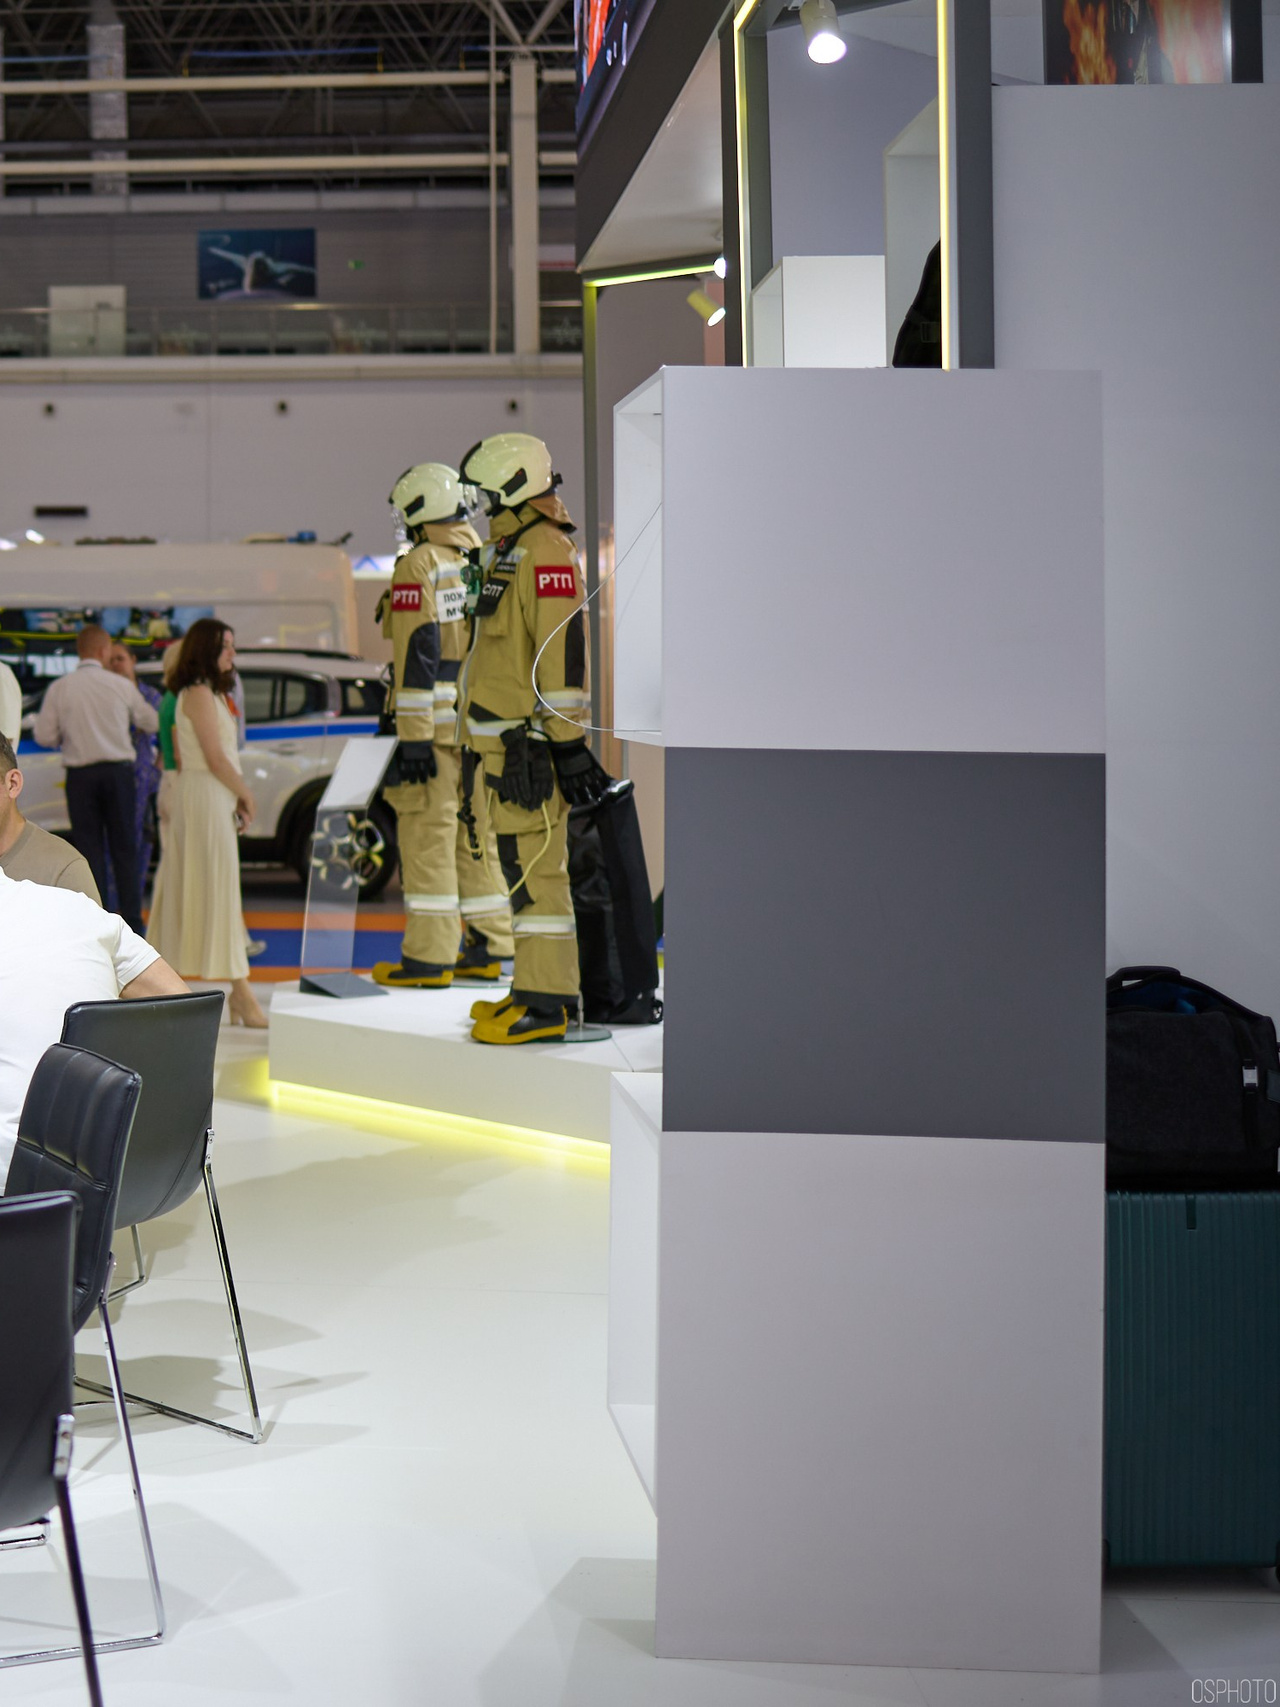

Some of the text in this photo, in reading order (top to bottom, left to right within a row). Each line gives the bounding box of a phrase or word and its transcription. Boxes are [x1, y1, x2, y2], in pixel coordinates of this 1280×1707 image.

[538, 572, 573, 590] РТП
[393, 588, 420, 605] РТП
[443, 591, 465, 604] ПОЖ
[481, 582, 504, 598] СПТ
